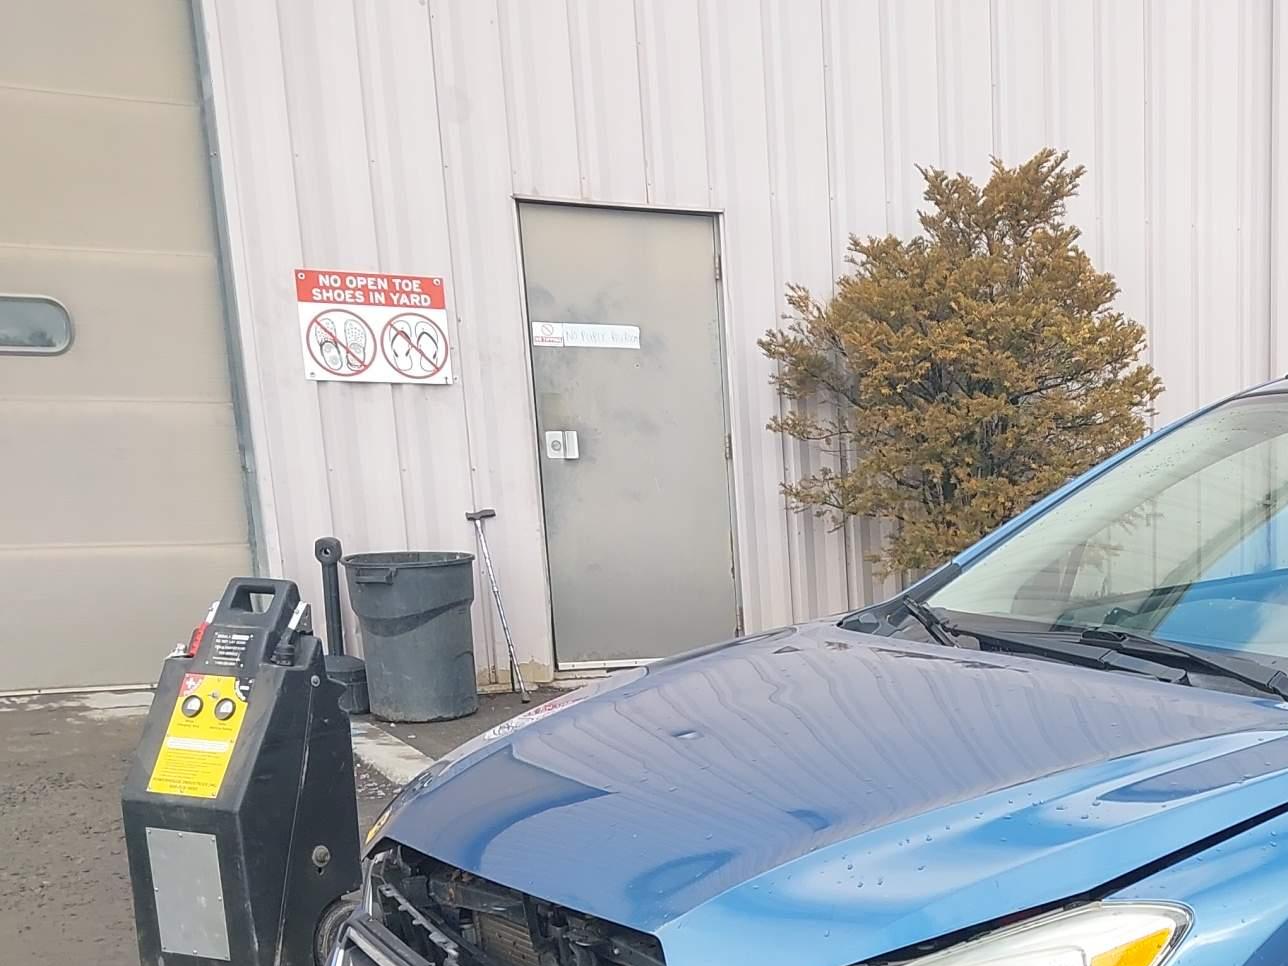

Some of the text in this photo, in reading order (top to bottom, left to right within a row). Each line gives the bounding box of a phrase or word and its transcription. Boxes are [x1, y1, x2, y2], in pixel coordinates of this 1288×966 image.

[319, 274, 422, 292] NO OPEN TOE
[311, 287, 431, 306] SHOES IN YARD
